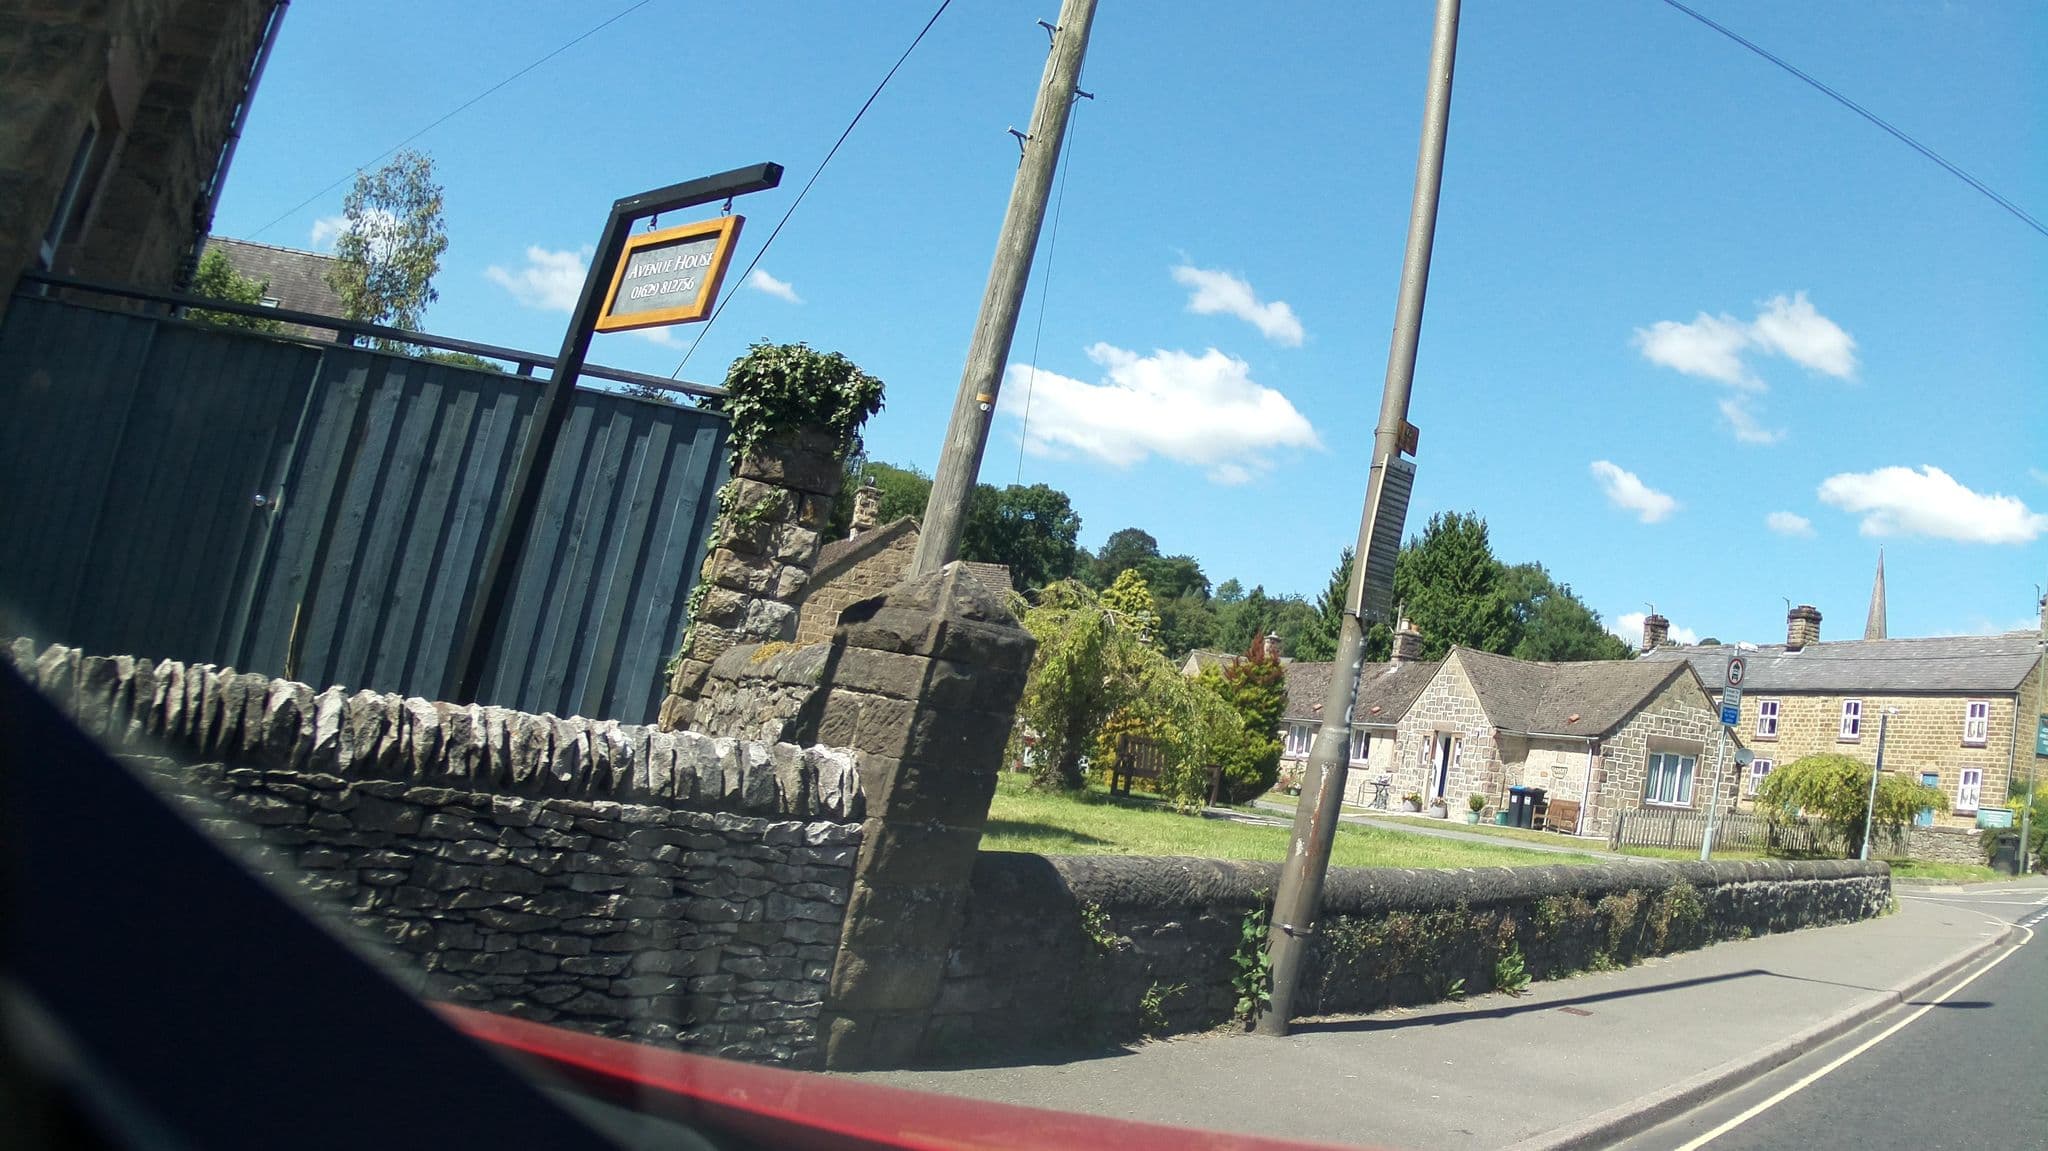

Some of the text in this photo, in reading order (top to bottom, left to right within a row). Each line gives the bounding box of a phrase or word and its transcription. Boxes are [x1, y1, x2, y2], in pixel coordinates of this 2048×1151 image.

[628, 252, 713, 279] AVENUE HOUSE
[630, 277, 695, 299] 01629 812756
